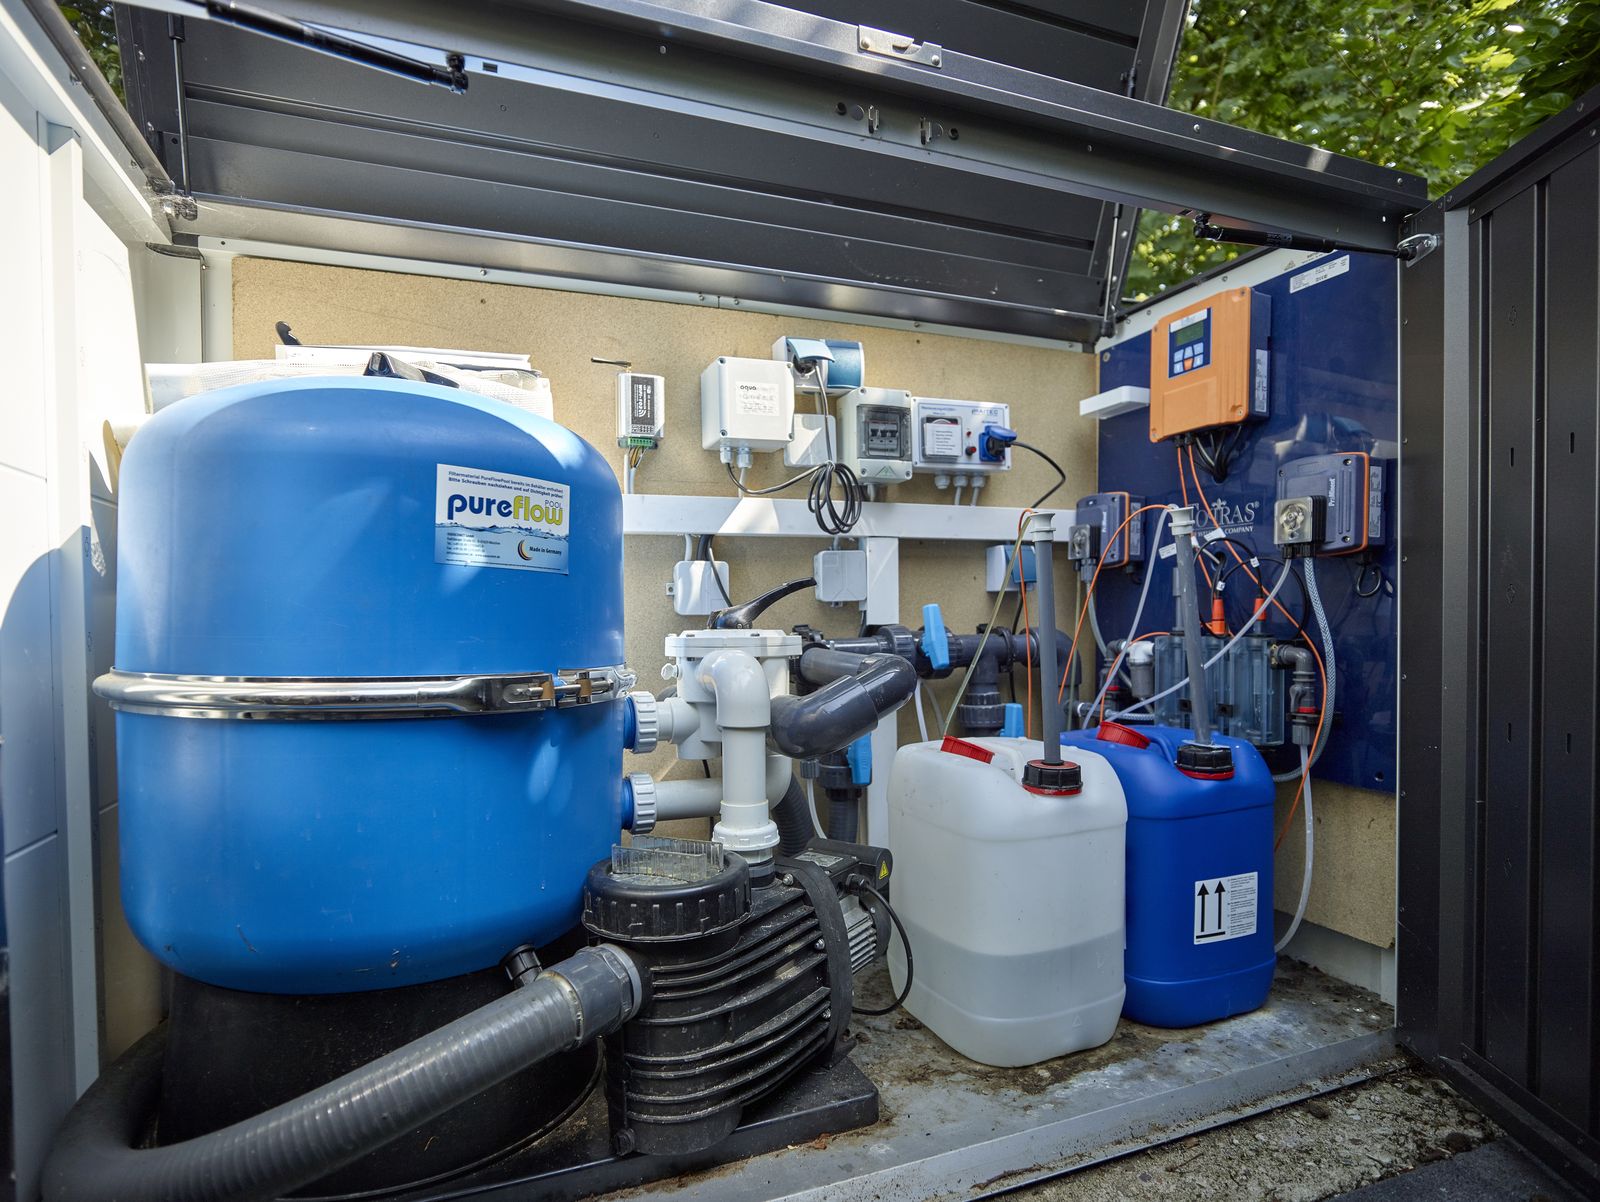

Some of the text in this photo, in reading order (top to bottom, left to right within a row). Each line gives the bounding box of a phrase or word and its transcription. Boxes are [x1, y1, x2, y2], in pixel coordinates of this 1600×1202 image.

[544, 499, 562, 508] POOL
[447, 494, 563, 526] pureflow
[1225, 526, 1253, 534] COMPANY
